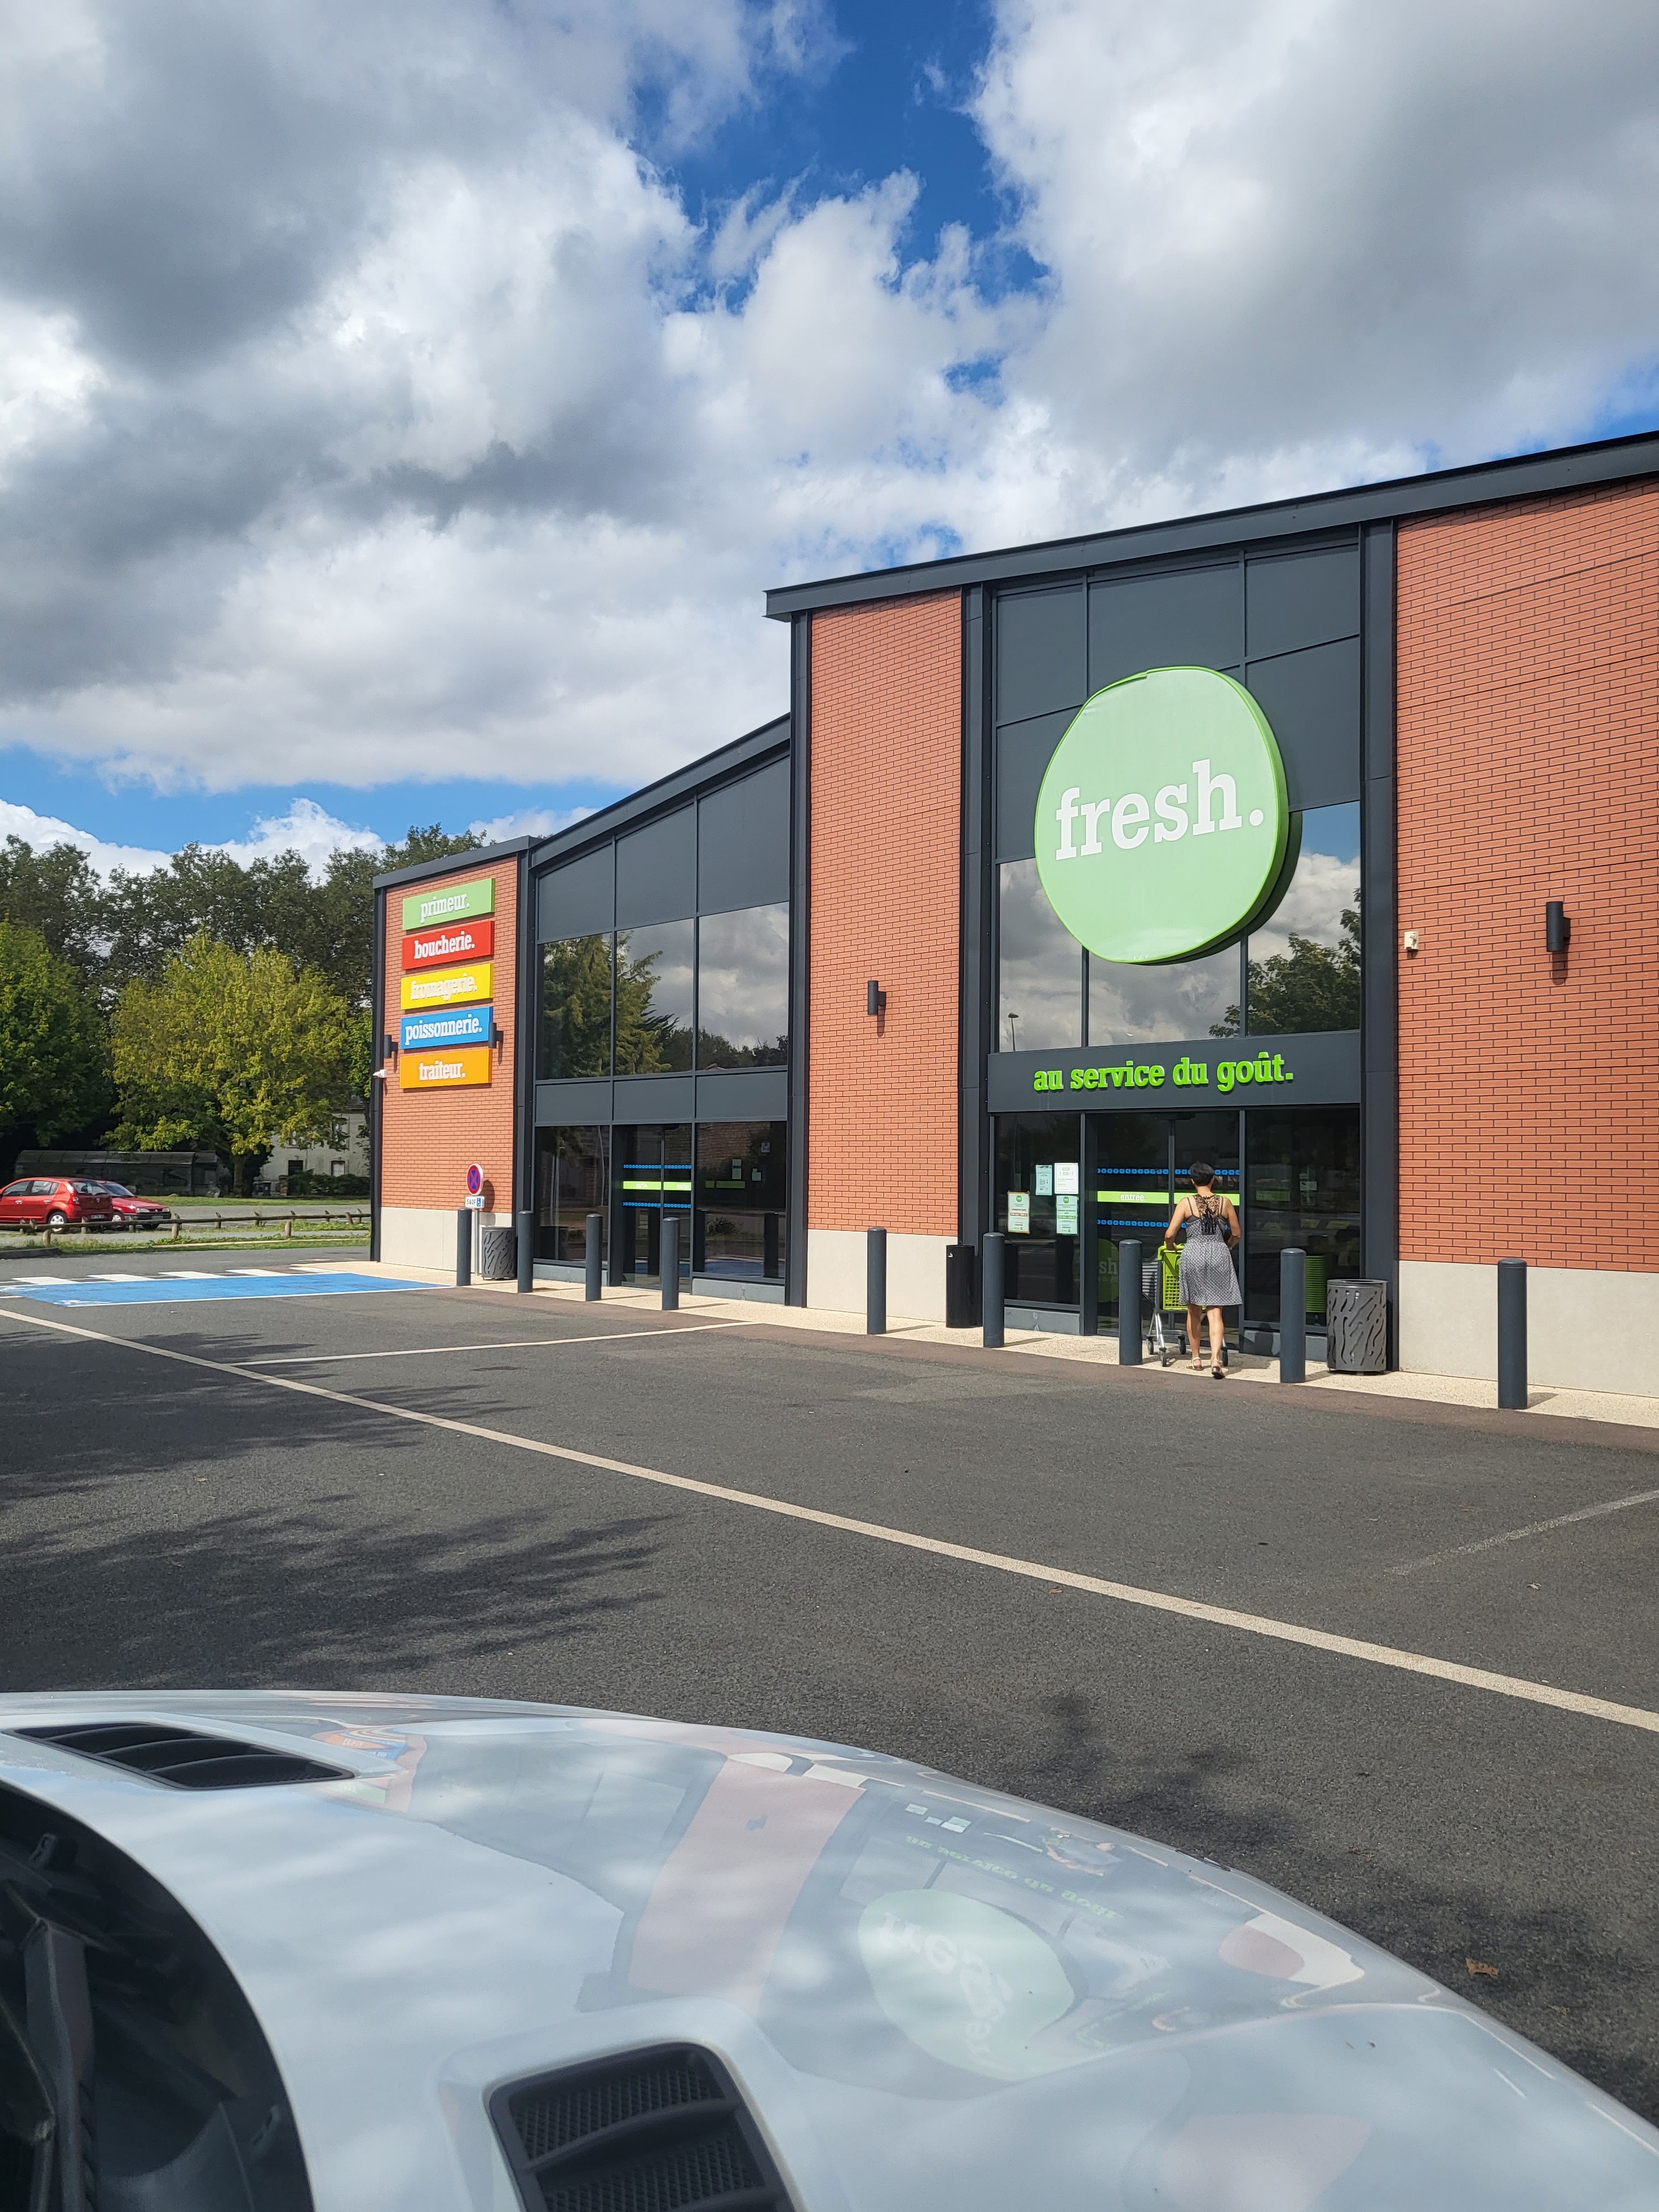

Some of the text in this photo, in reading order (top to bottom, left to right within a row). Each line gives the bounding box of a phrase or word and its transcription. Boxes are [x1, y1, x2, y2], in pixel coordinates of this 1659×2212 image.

[1055, 758, 1264, 860] fresh.
[420, 893, 470, 924] primeur.
[413, 931, 476, 959] boucherie.
[410, 973, 478, 1001] fromagerie.
[404, 1014, 483, 1046] poissonnerie.
[419, 1060, 466, 1081] traiteur.
[1033, 1051, 1294, 1093] au service du goût.
